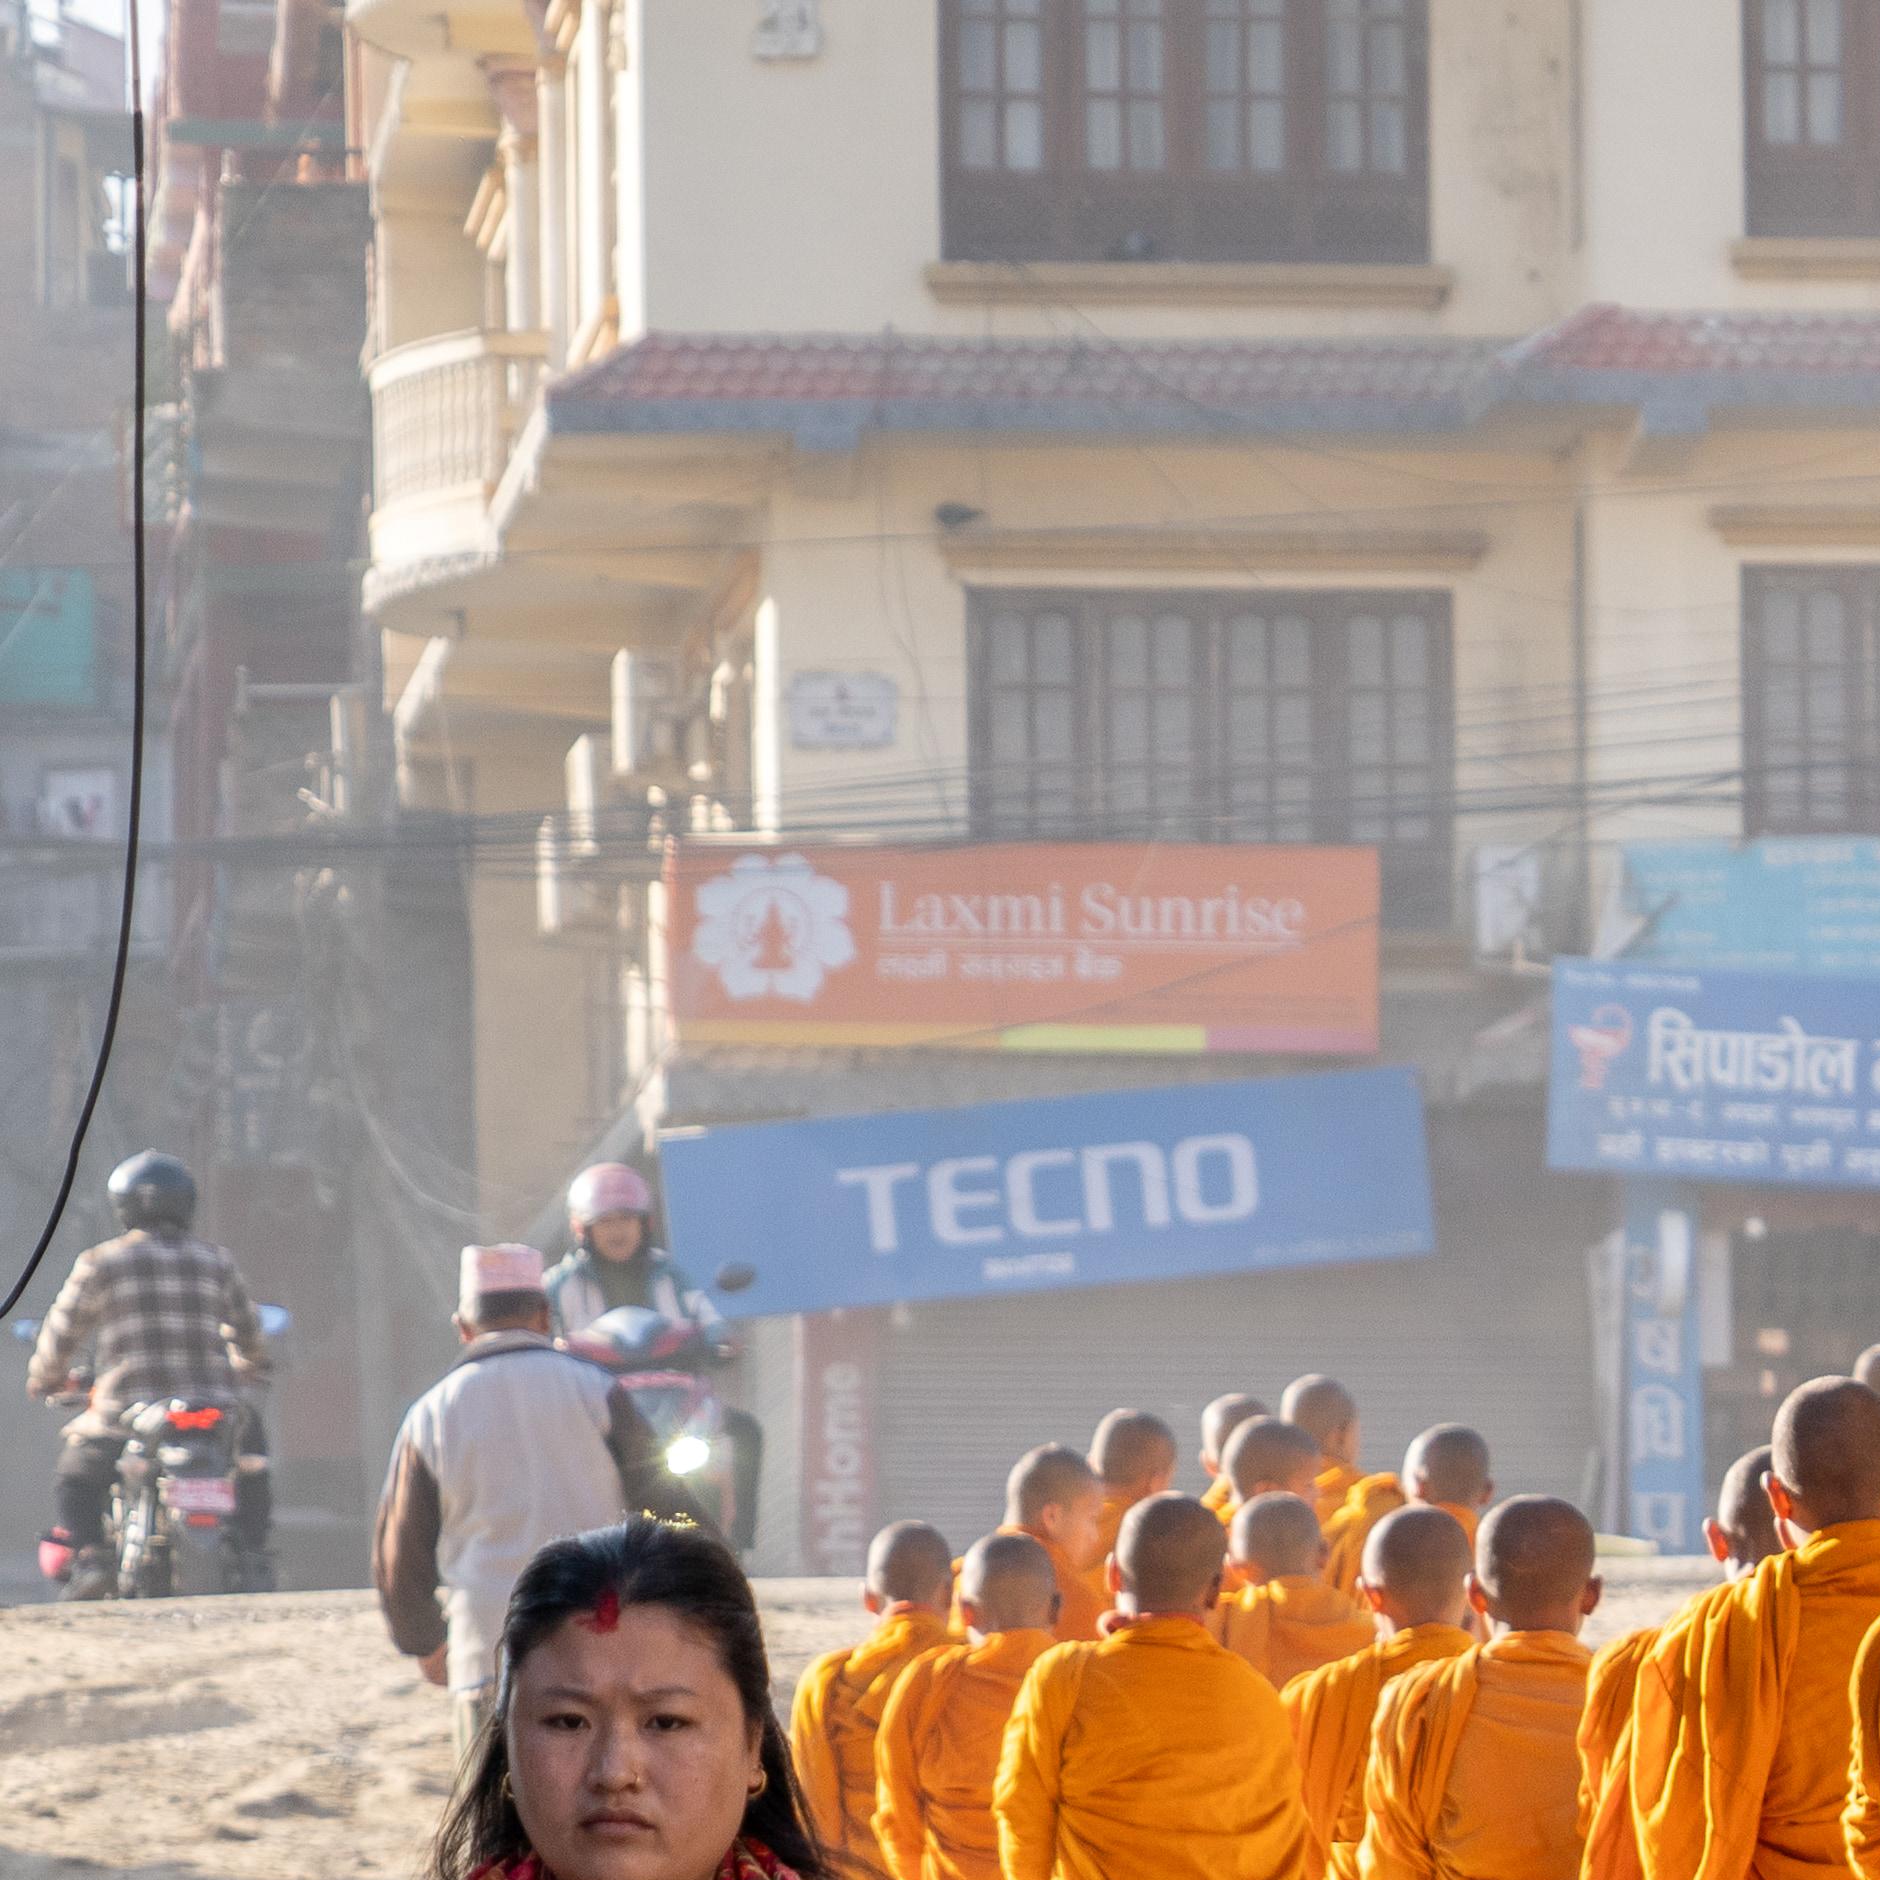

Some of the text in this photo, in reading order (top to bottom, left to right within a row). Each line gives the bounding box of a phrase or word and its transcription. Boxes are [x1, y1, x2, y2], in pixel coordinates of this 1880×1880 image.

[878, 880, 1306, 936] Laxmi Sunrise
[1648, 1005, 1859, 1095] सिपाडोल
[836, 1132, 1259, 1254] TECNO
